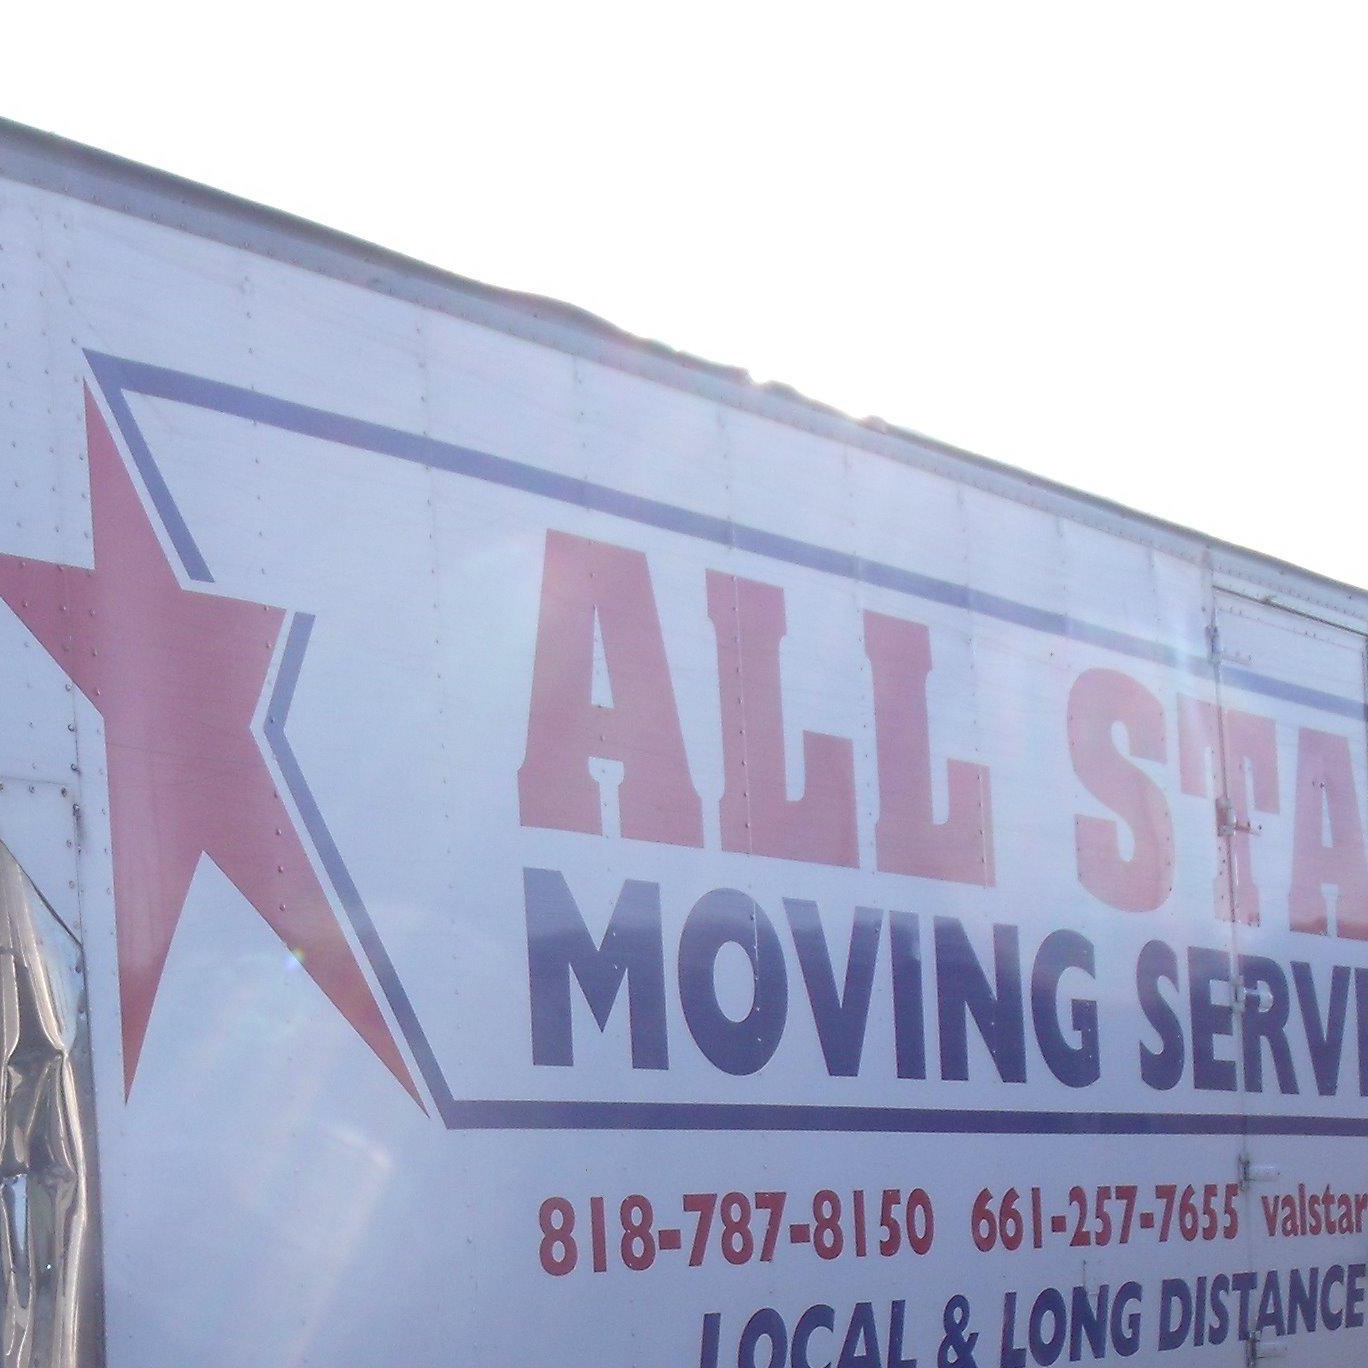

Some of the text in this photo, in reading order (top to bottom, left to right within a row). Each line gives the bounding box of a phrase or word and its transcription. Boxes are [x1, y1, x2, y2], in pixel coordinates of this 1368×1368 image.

[517, 528, 1368, 942] ALL STA
[522, 866, 1100, 1088] MOVING
[539, 1188, 934, 1276] 818-787-8150
[971, 1183, 1239, 1252] 661-257-7655
[1158, 1264, 1366, 1351] DISTANCE
